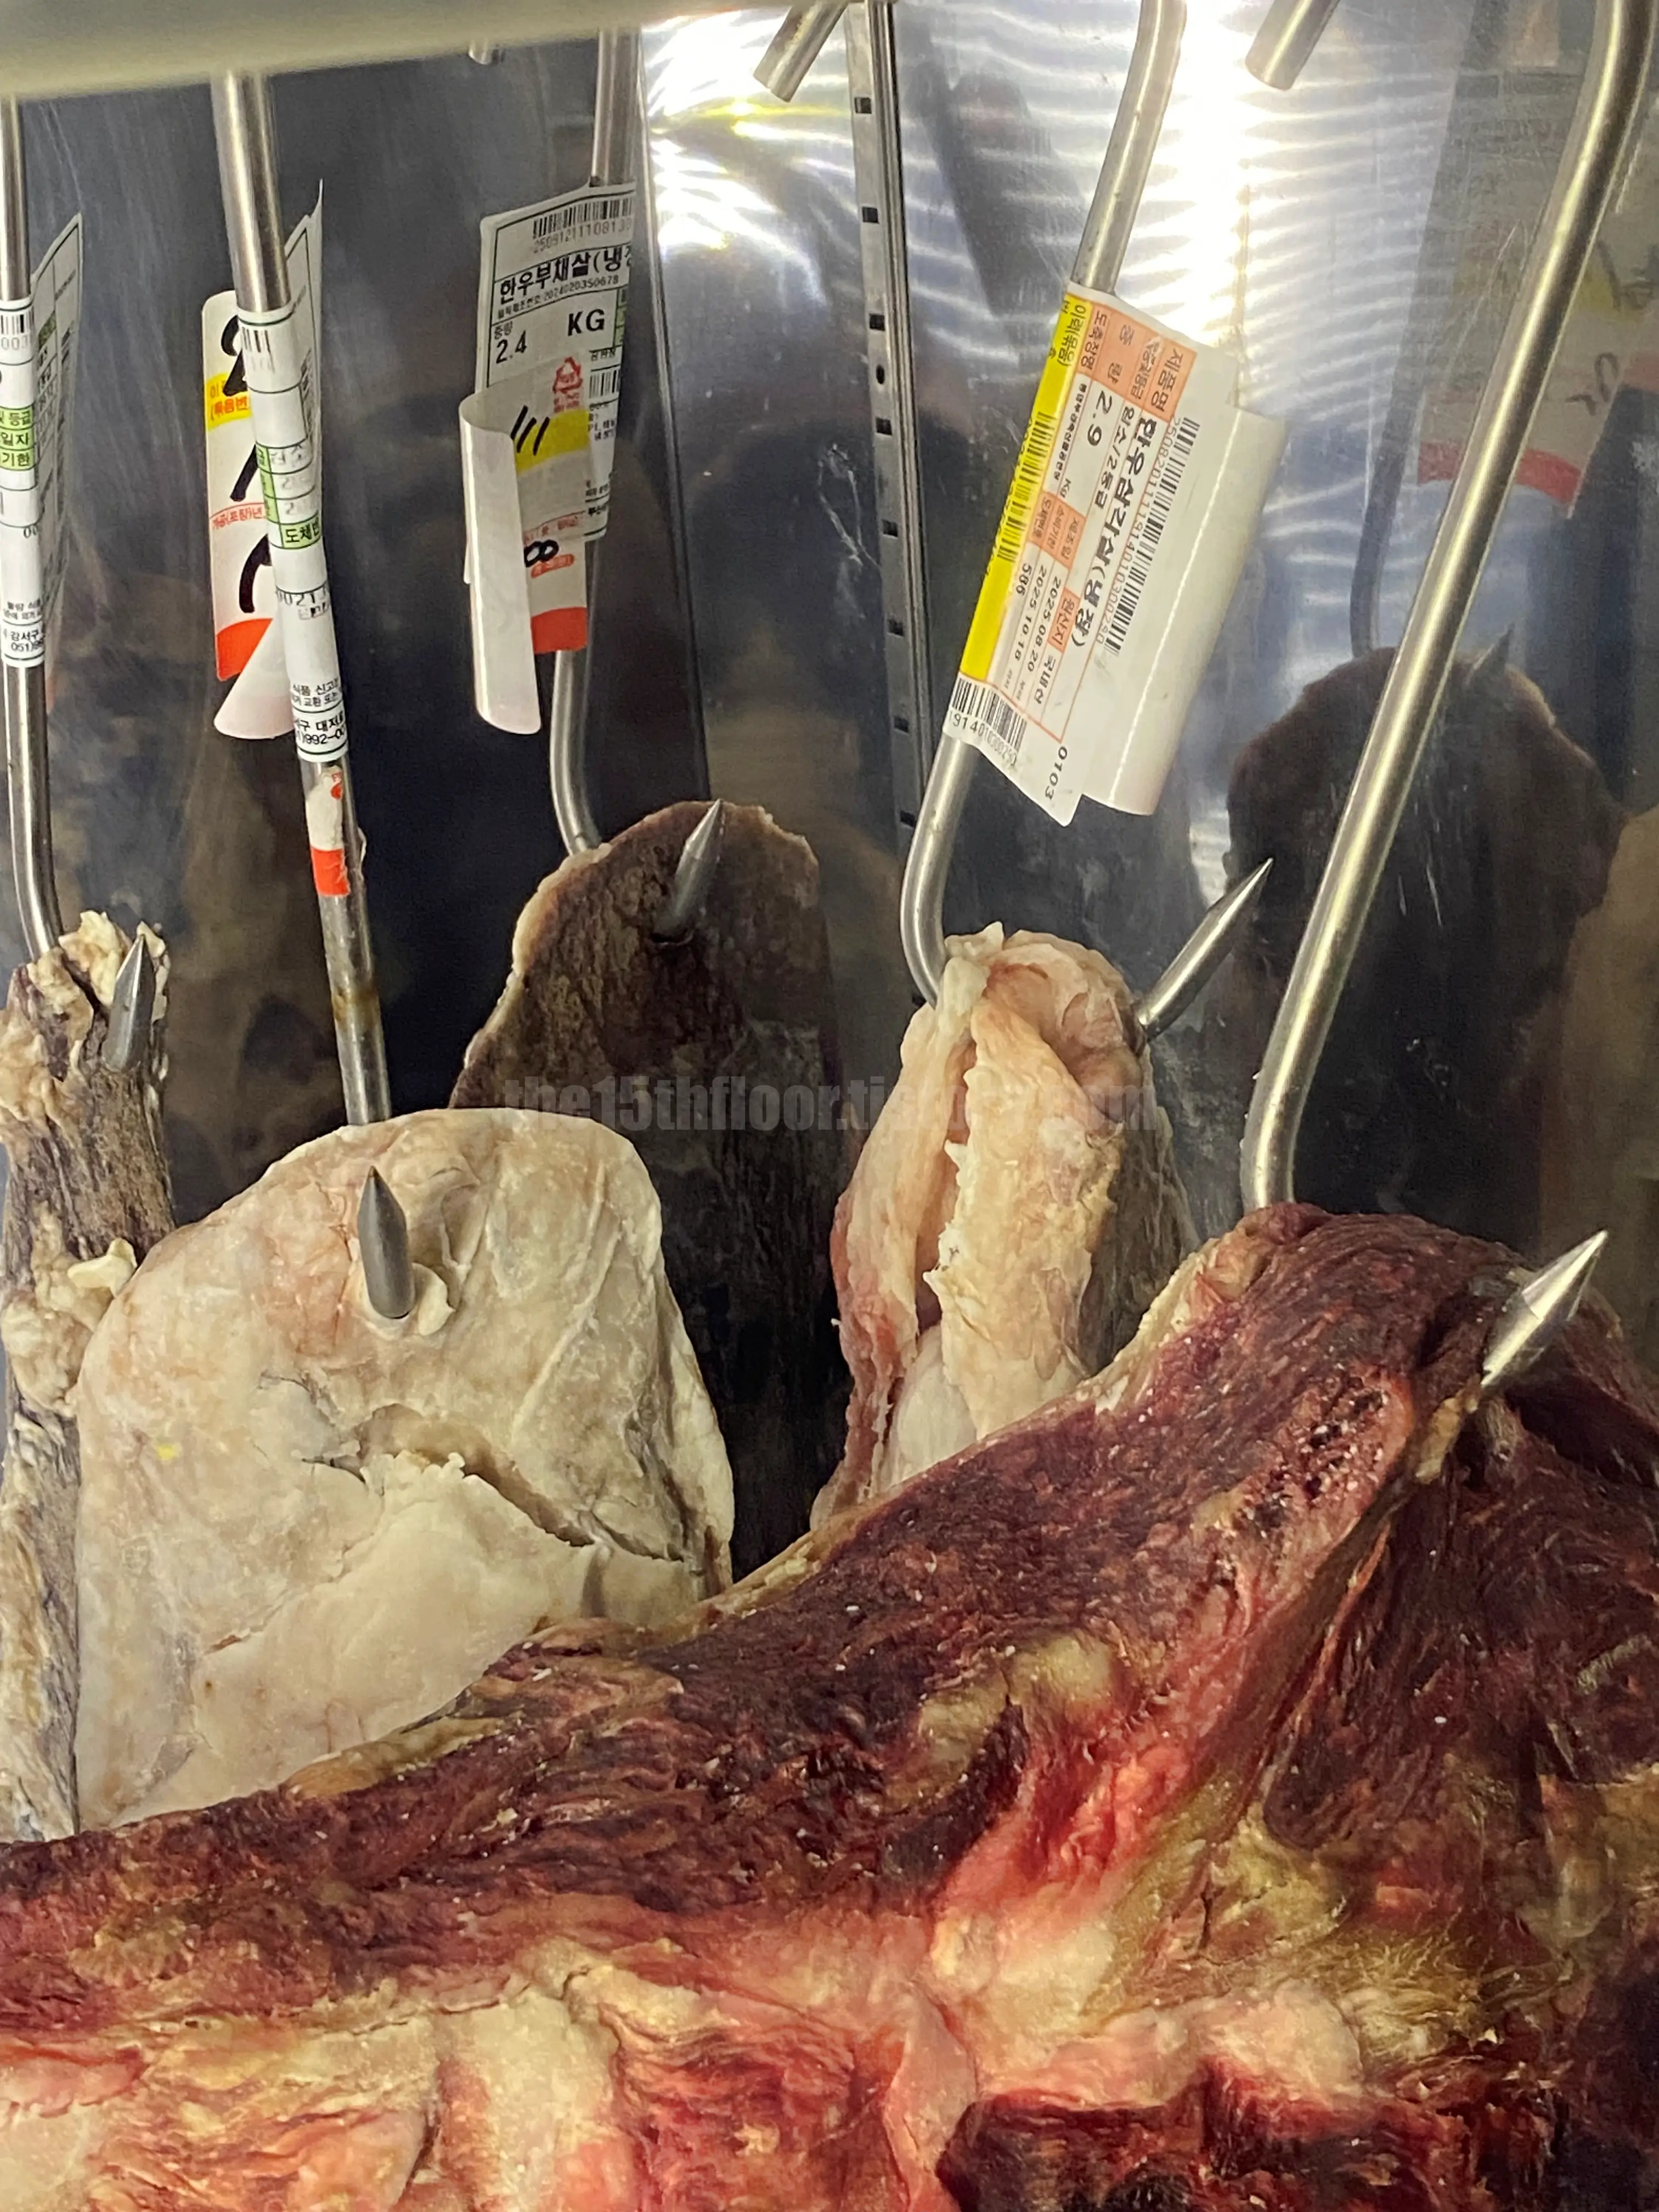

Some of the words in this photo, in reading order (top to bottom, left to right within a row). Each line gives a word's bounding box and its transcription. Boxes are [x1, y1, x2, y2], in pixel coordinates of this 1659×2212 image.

[496, 330, 527, 364] 2.4
[567, 308, 605, 336] KG
[1056, 303, 1087, 368] 이력(묶음)
[1079, 310, 1107, 370] 도축장명
[1150, 348, 1183, 411] 제품명
[1085, 390, 1114, 447] 2.9
[1046, 505, 1066, 549] 소비기한
[1060, 517, 1080, 561] 제조일
[1071, 416, 1156, 649] 한우삼각살(냉장)
[1050, 596, 1075, 645] 원산지
[1032, 654, 1056, 705] 국내산
[1043, 746, 1068, 801] 0103
